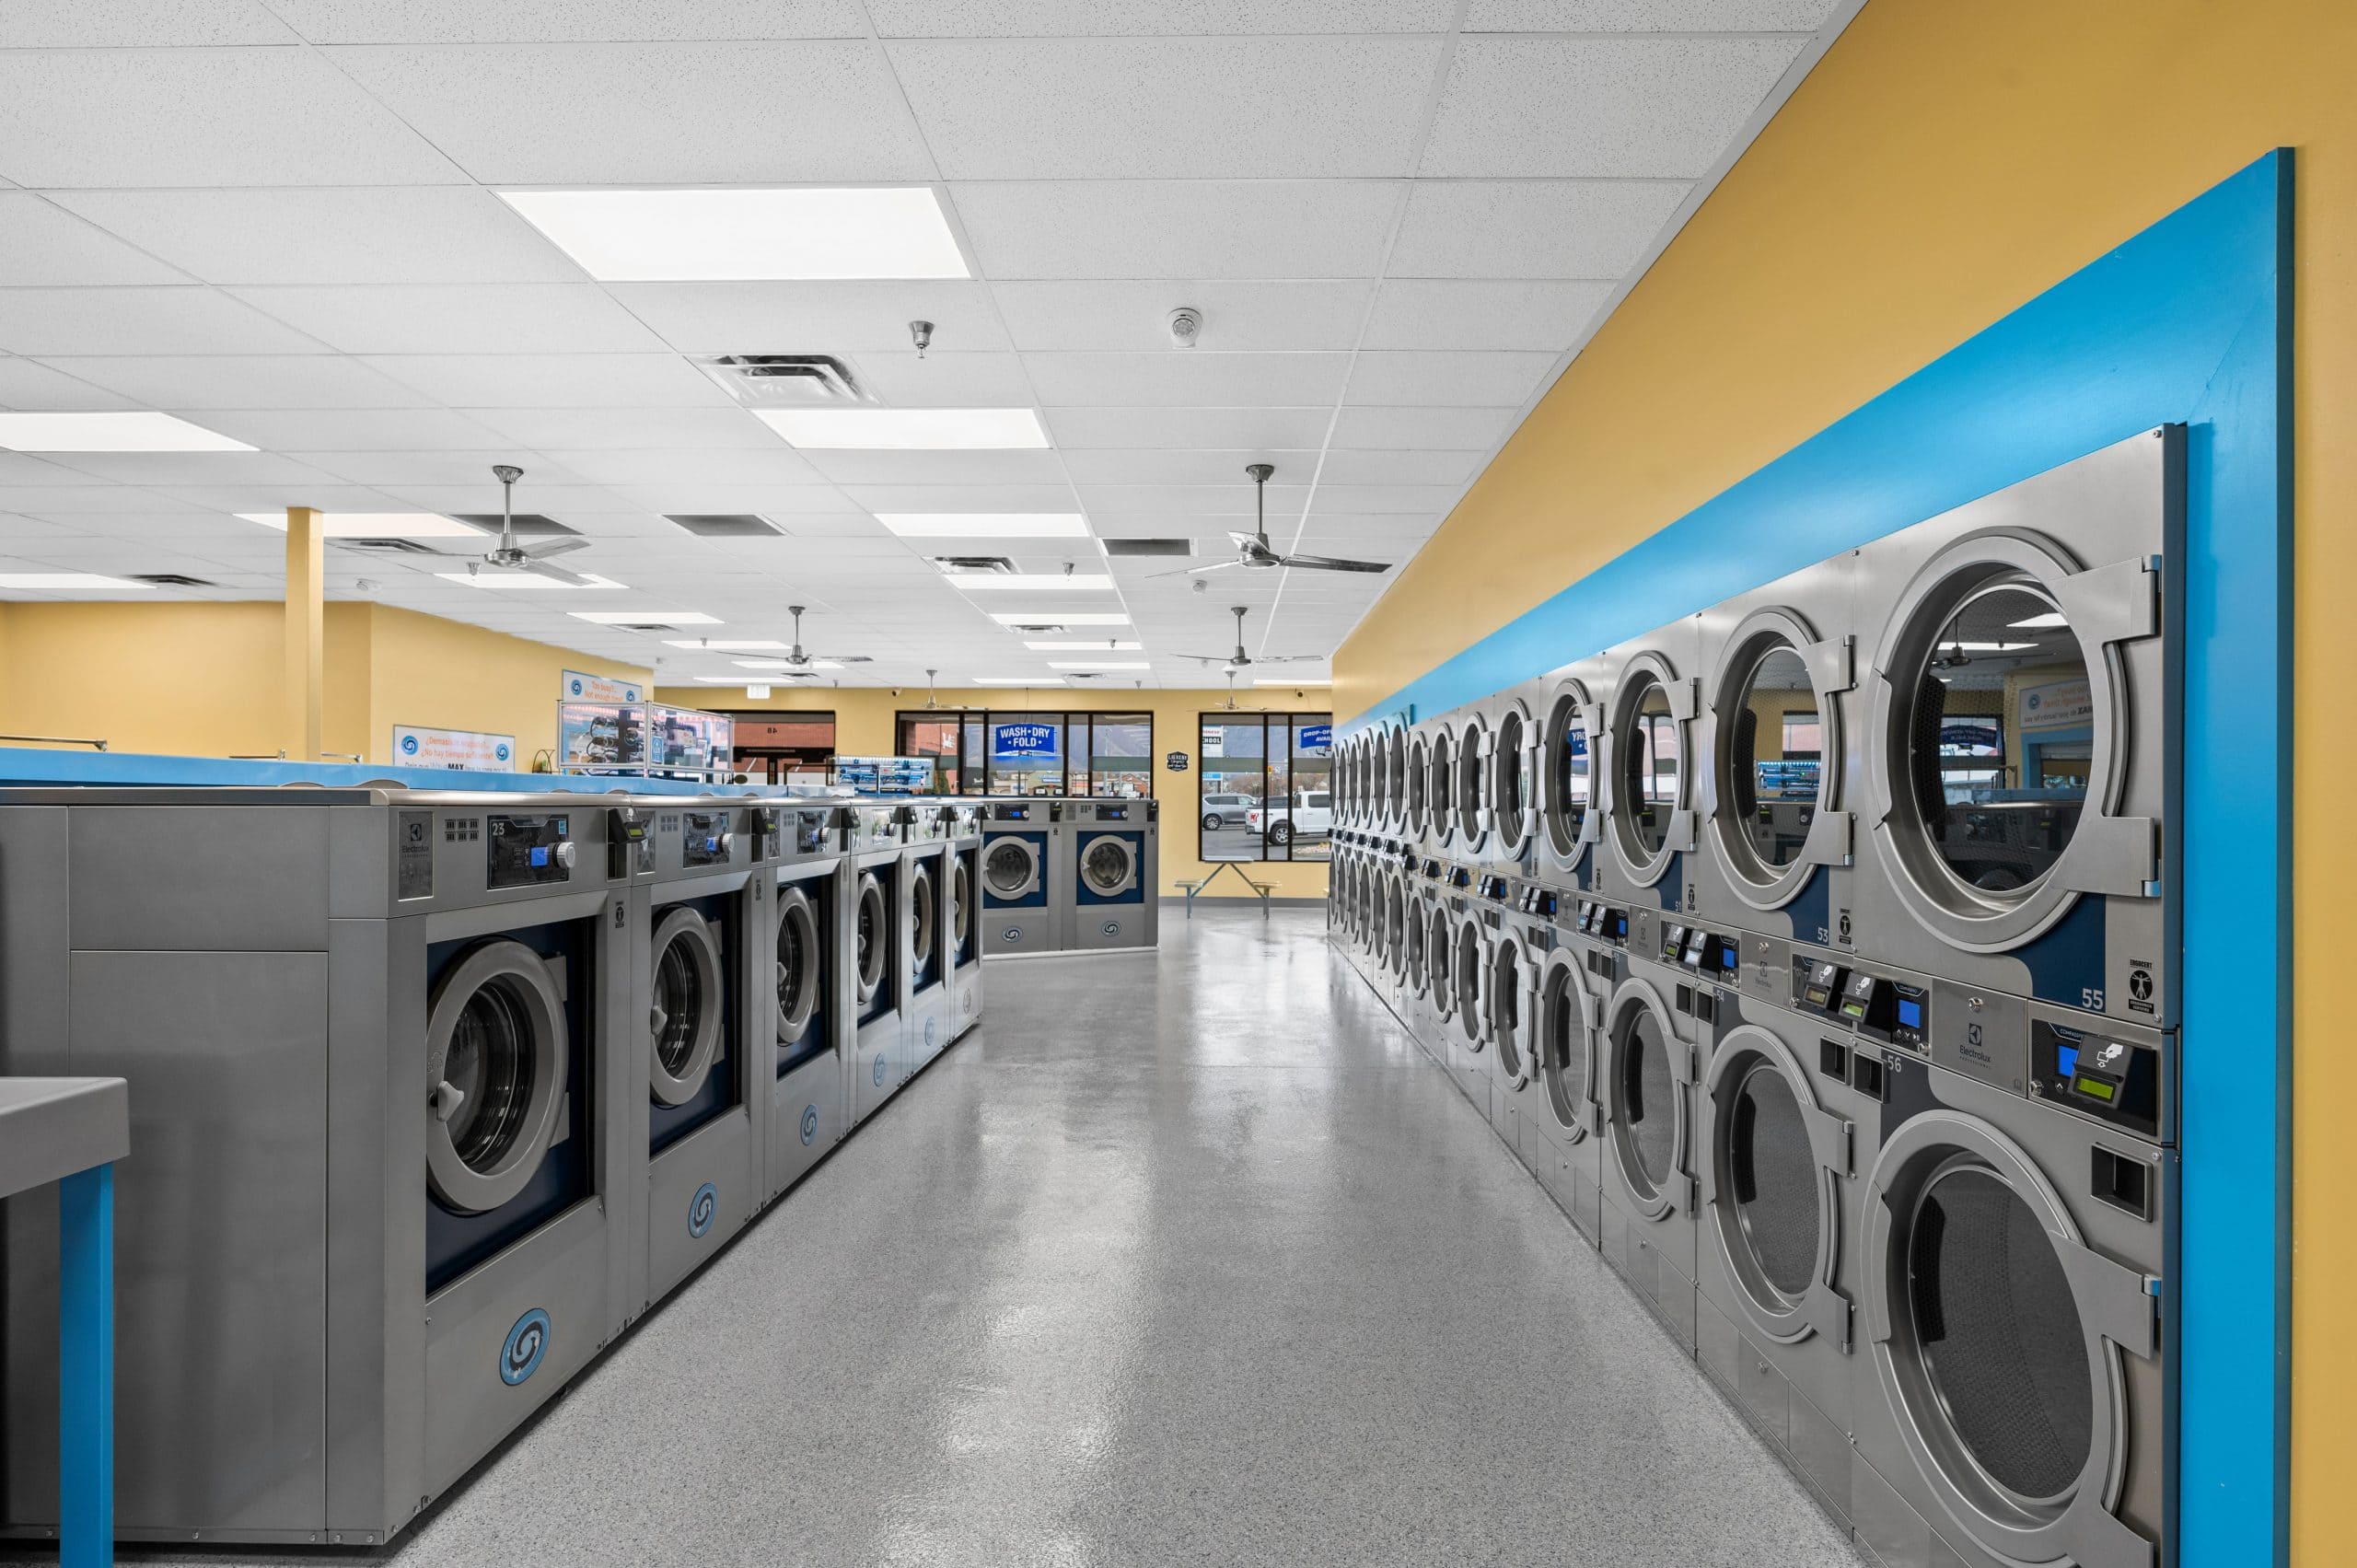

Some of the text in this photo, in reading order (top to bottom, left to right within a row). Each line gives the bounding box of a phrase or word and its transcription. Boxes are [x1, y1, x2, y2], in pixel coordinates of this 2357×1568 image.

[1000, 726, 1050, 738] WASH DRY
[1013, 737, 1037, 748] FOLD
[493, 822, 505, 835] 23
[1817, 927, 1829, 942] 53
[1716, 990, 1724, 1003] 54
[2082, 988, 2104, 1010] 55
[1959, 1044, 1991, 1063] Electrolux
[1887, 1054, 1902, 1073] 56
